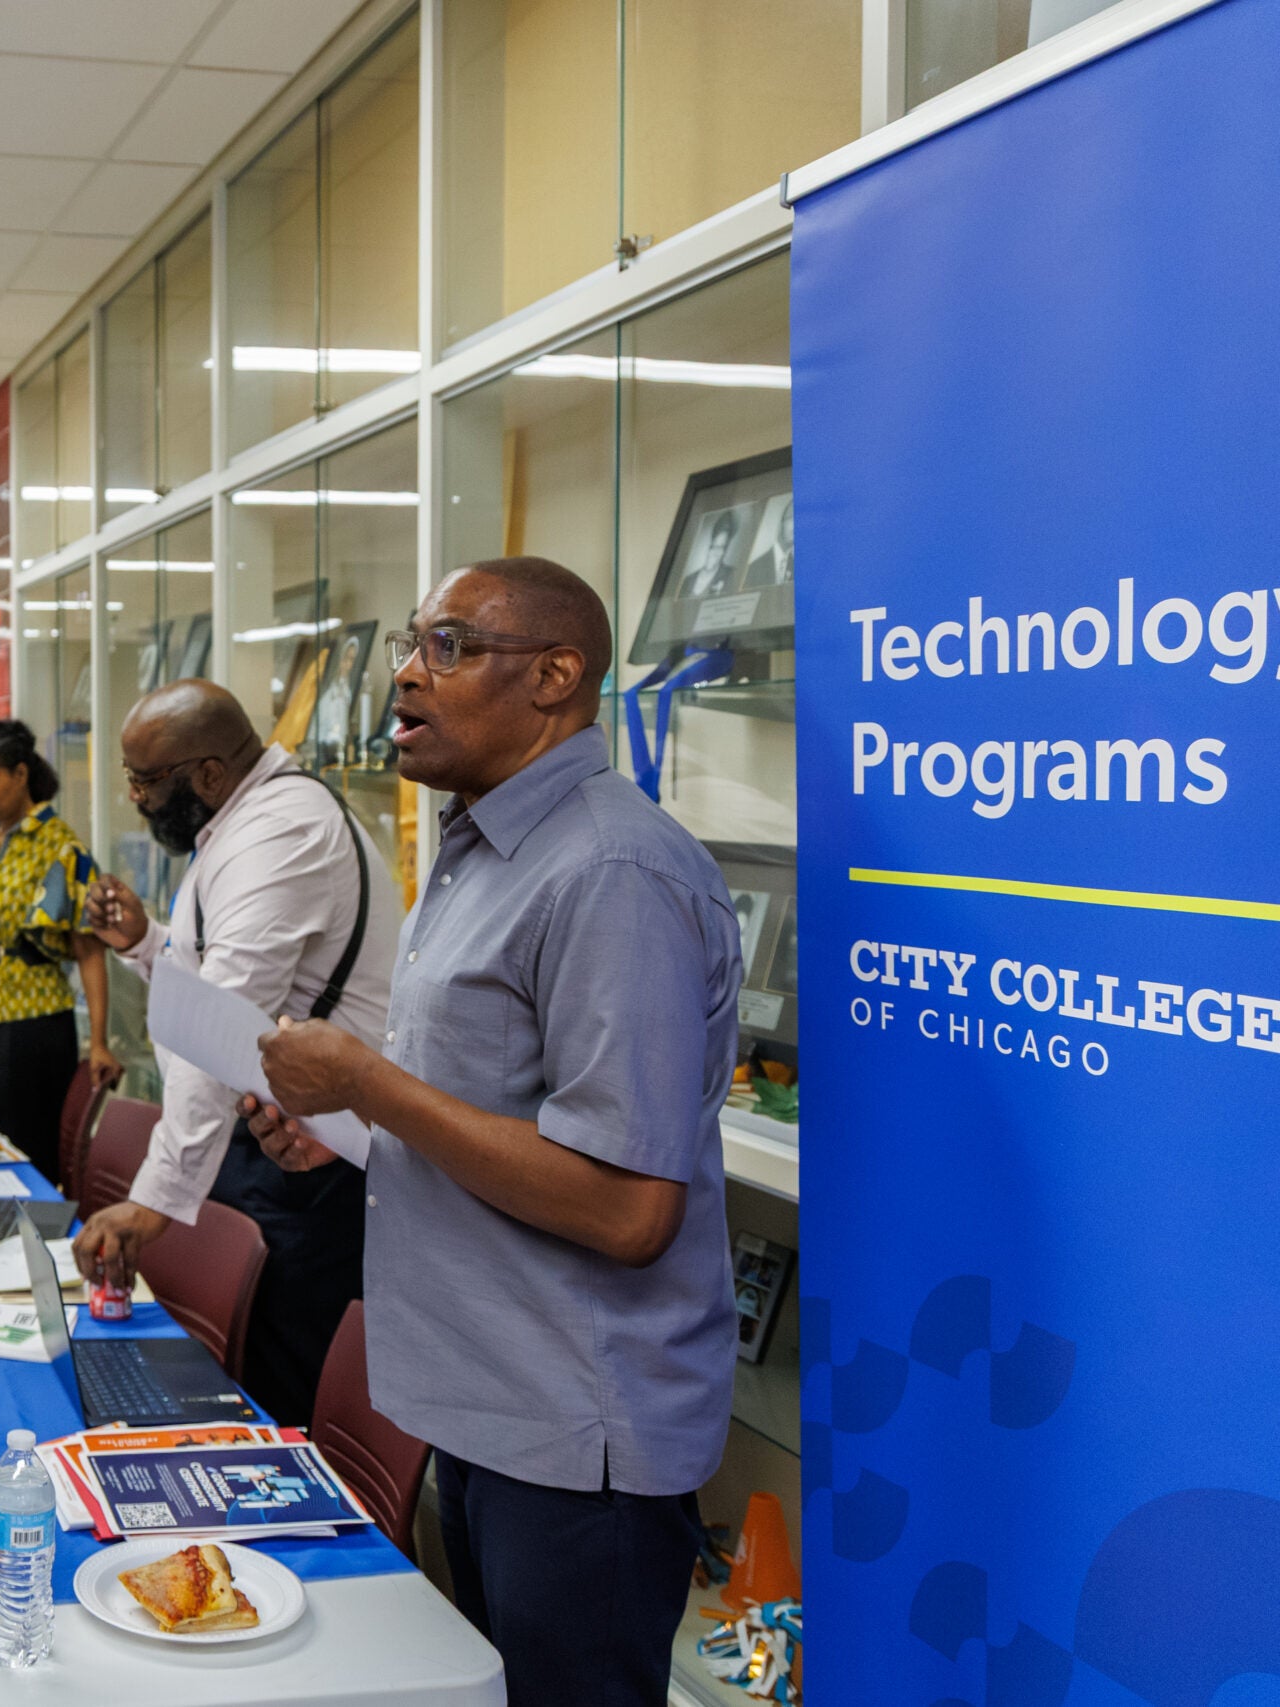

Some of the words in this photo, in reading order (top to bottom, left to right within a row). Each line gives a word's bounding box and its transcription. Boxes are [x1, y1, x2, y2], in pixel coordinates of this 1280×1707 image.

[850, 577, 1280, 685] Technolog
[853, 722, 1228, 820] Programs
[850, 940, 976, 997] CITY
[990, 958, 1280, 1054] COLLEGE
[850, 997, 895, 1030] OF
[919, 1008, 1110, 1077] CHICAGO
